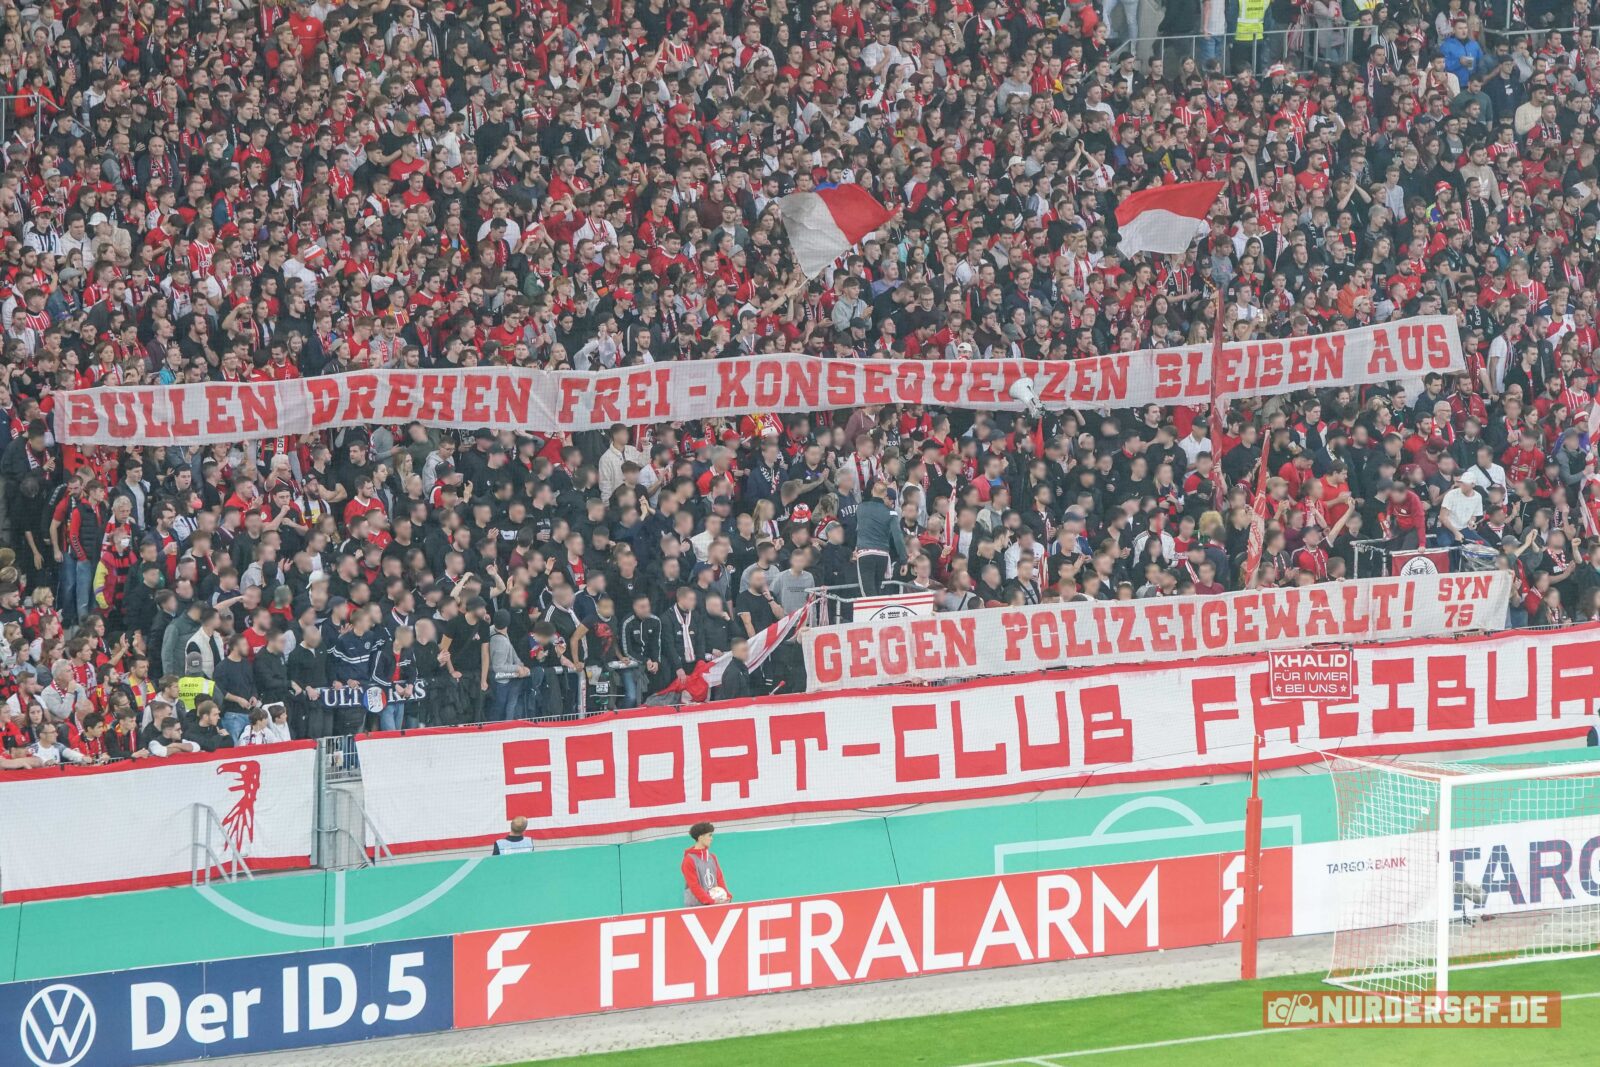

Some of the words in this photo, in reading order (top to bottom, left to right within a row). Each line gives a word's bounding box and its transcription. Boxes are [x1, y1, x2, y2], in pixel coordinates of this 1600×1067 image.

[68, 384, 279, 438] BULLEN
[306, 373, 533, 426] DREHEN
[558, 368, 671, 423] FREI
[1155, 334, 1347, 399] BLEIBEN
[1367, 324, 1452, 375] AUS
[814, 617, 977, 683] GEGEN
[1002, 580, 1415, 662] POLIZEIGEWALT!
[1437, 575, 1493, 601] SYN
[1273, 669, 1301, 682] FÜR
[1304, 672, 1348, 681] IMMER
[1274, 654, 1348, 668] KHALID
[1285, 684, 1305, 693] BEI
[1309, 684, 1338, 693] UNS
[502, 684, 1134, 821] SPORT-CLUB
[600, 864, 1159, 1008] FLYERALARM
[130, 982, 262, 1051] Der
[282, 951, 428, 1034] ID.5
